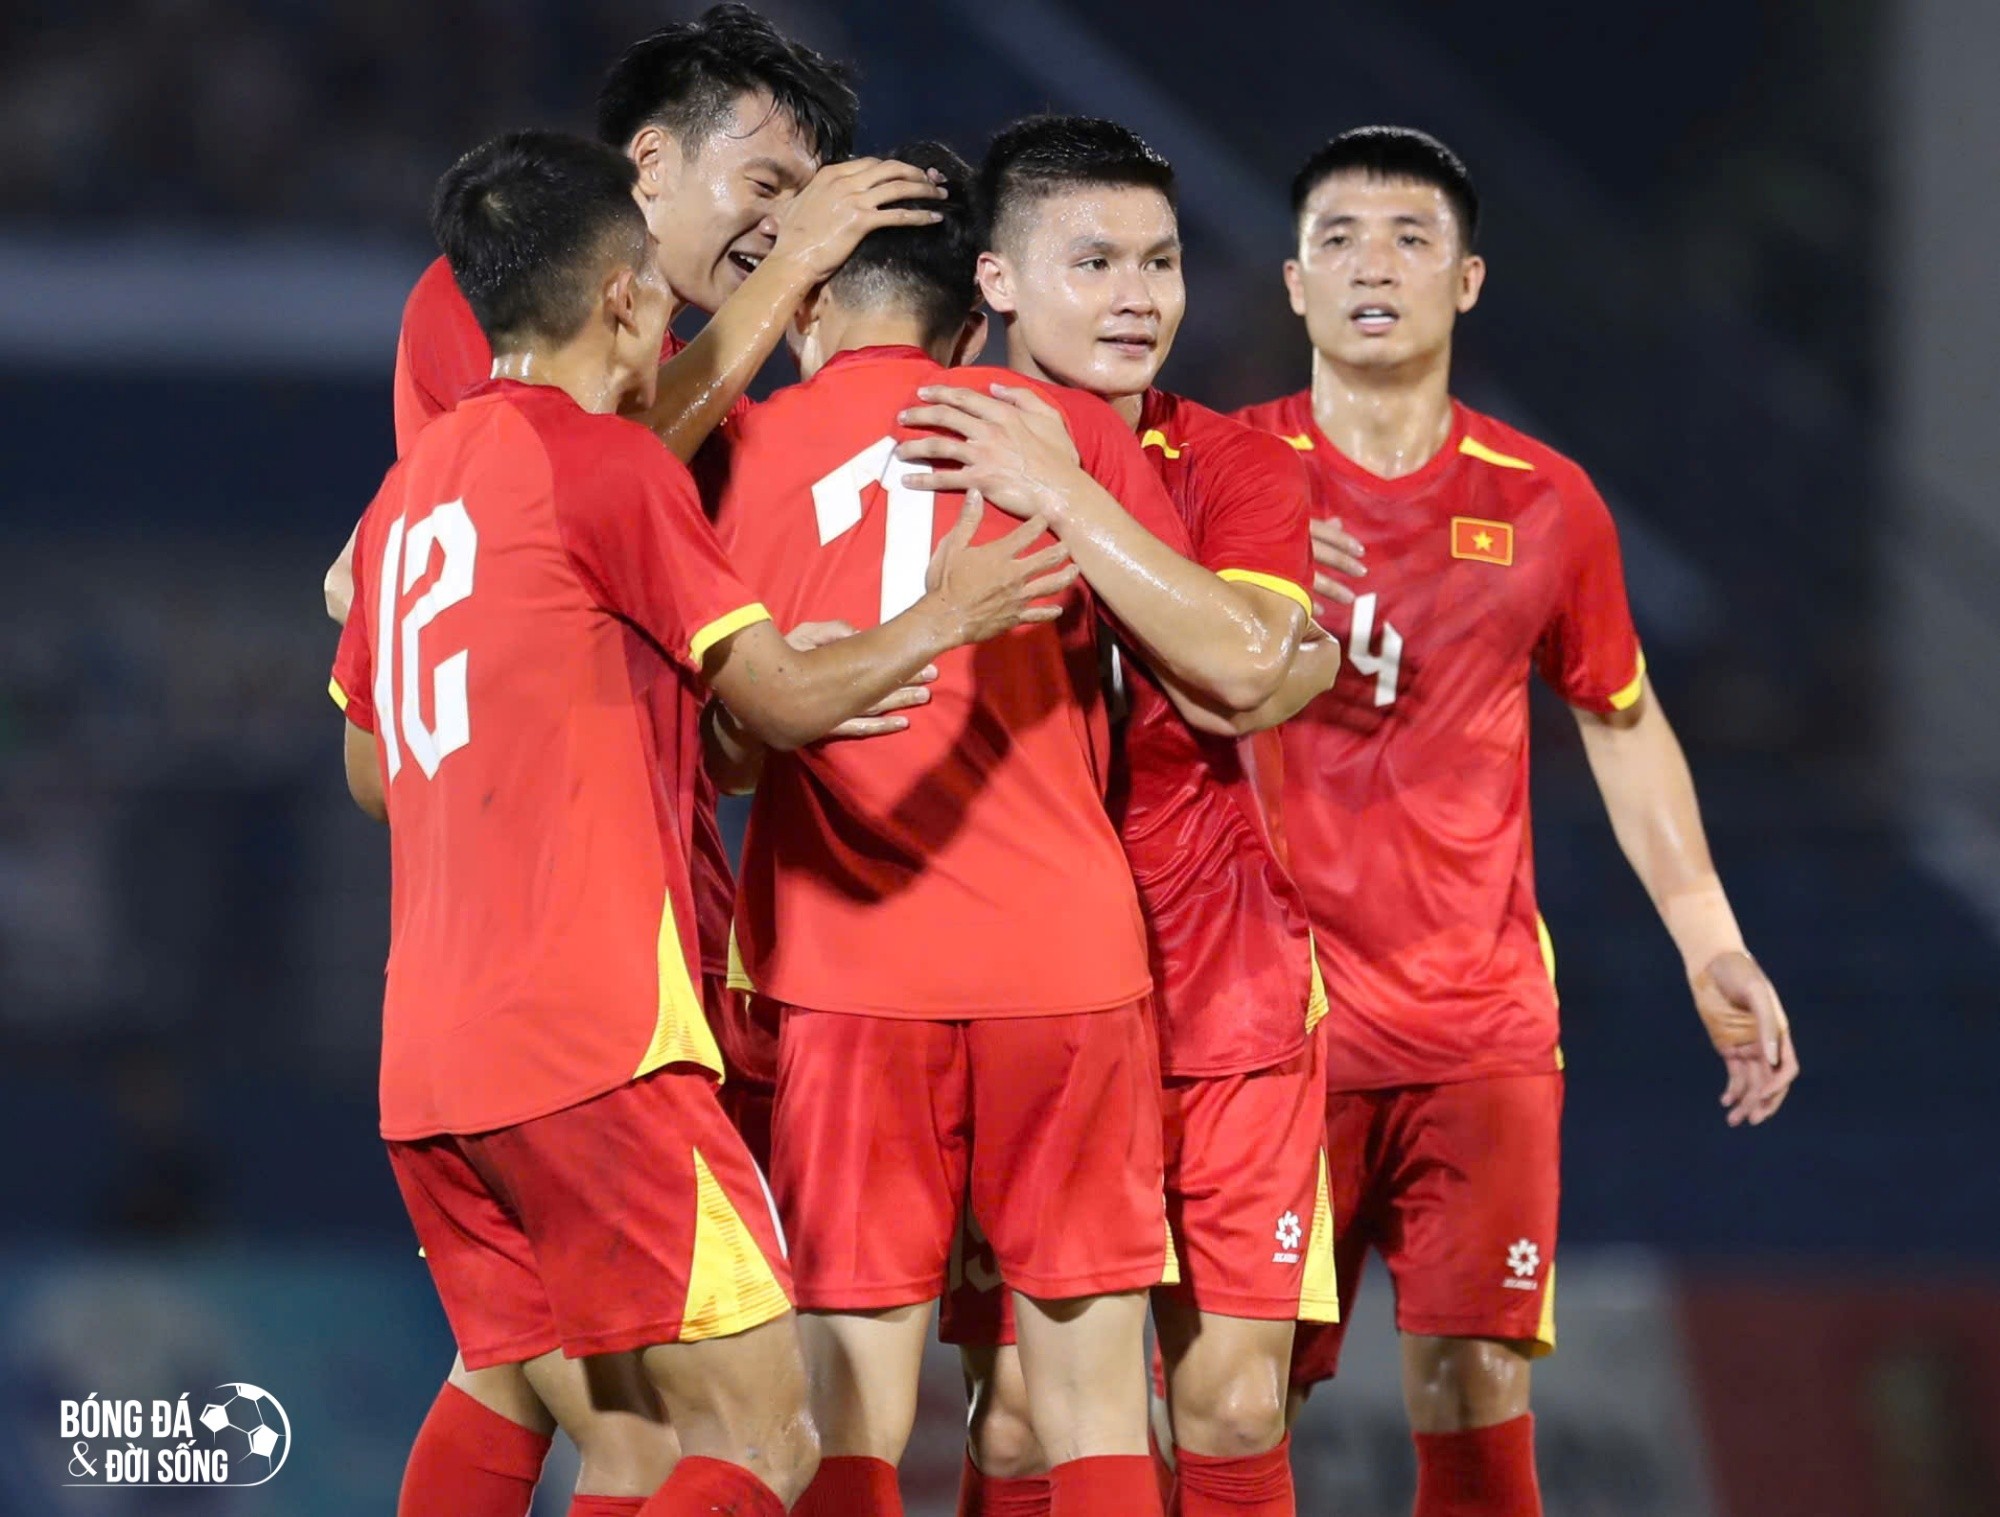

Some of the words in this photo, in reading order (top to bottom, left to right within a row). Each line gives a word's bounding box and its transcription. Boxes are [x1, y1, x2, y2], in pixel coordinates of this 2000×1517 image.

[811, 435, 935, 626] 7
[374, 497, 478, 785] 12
[1348, 592, 1403, 707] 4
